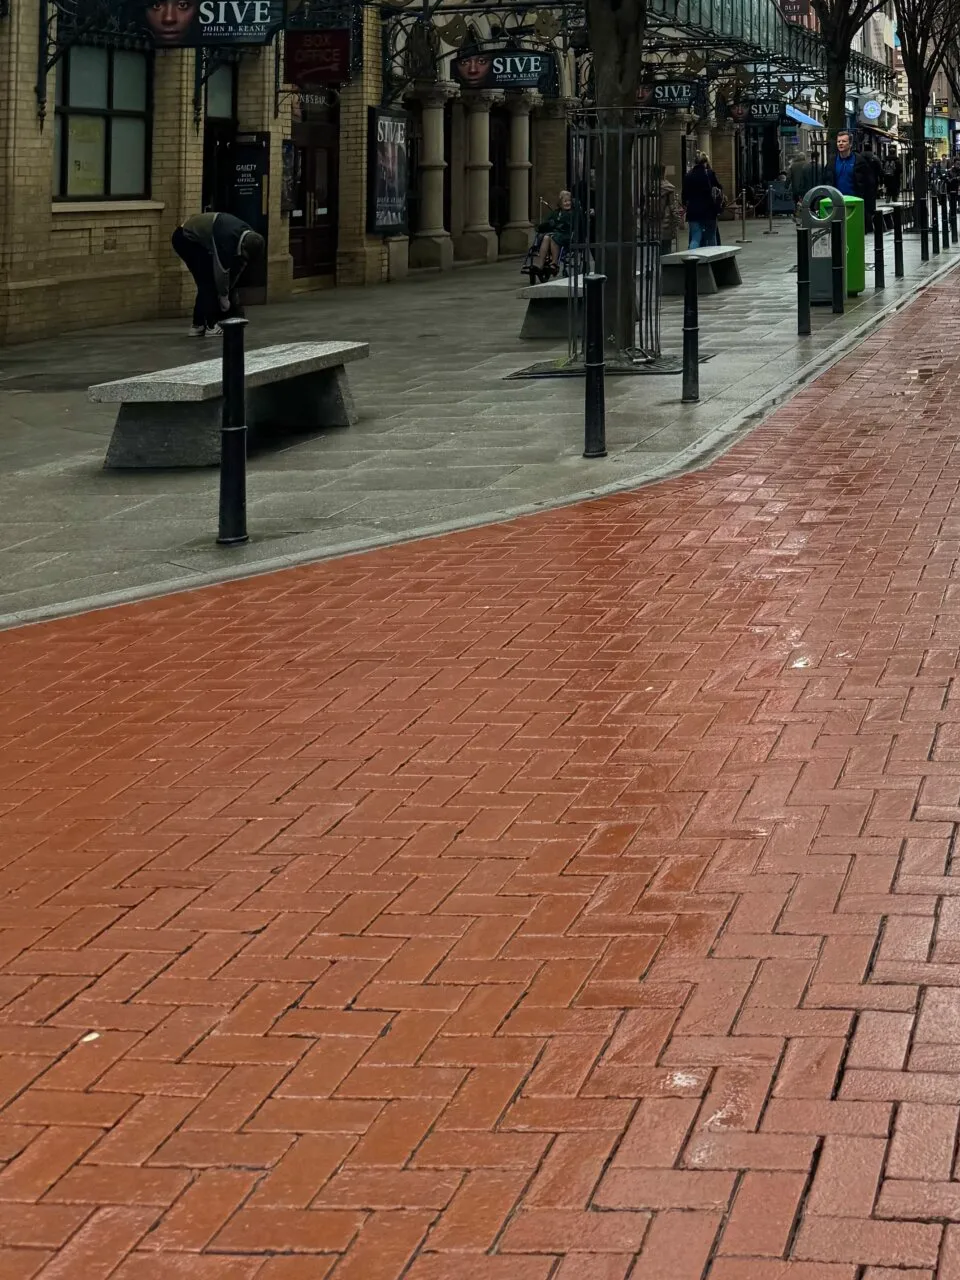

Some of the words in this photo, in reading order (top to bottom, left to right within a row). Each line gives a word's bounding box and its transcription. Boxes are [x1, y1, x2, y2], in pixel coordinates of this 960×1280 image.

[198, 0, 271, 24] SIVE
[303, 34, 332, 47] BOX
[295, 48, 340, 63] OFFICE
[492, 56, 542, 74] SIVE
[654, 85, 692, 99] SIVE
[751, 103, 780, 115] SIVE
[377, 120, 405, 143] SIVE
